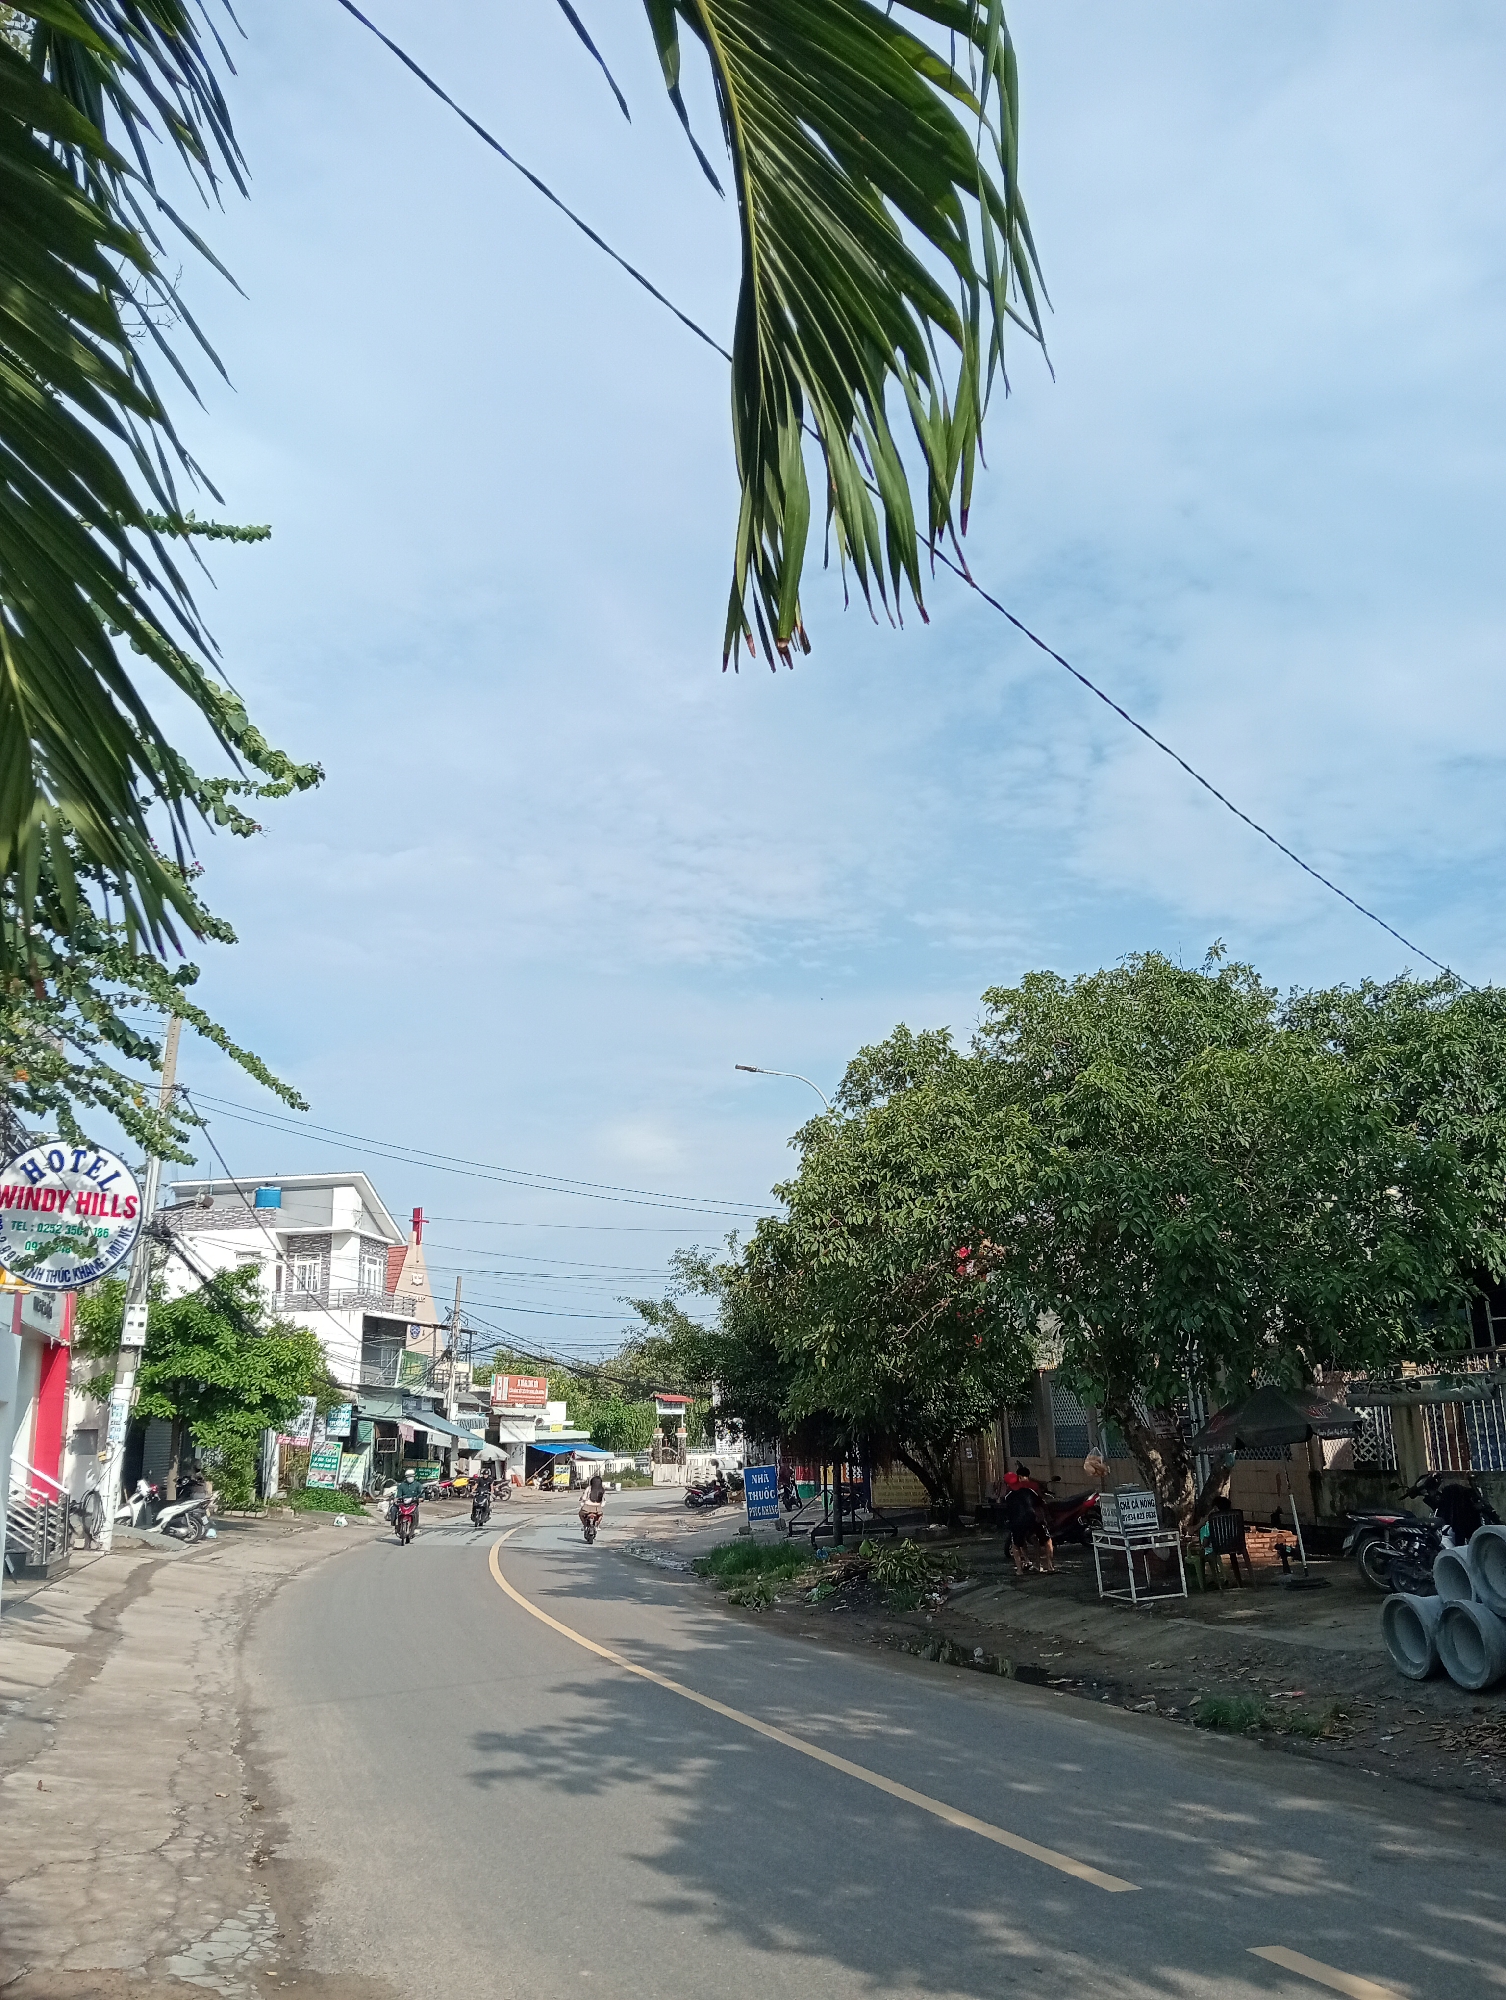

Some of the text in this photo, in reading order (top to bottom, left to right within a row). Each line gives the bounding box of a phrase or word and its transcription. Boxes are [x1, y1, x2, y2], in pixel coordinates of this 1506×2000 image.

[19, 1149, 122, 1192] HOTEL
[0, 1184, 138, 1219] WINDY HILLS
[751, 1470, 770, 1485] NHÀ
[747, 1485, 776, 1501] THUỐC
